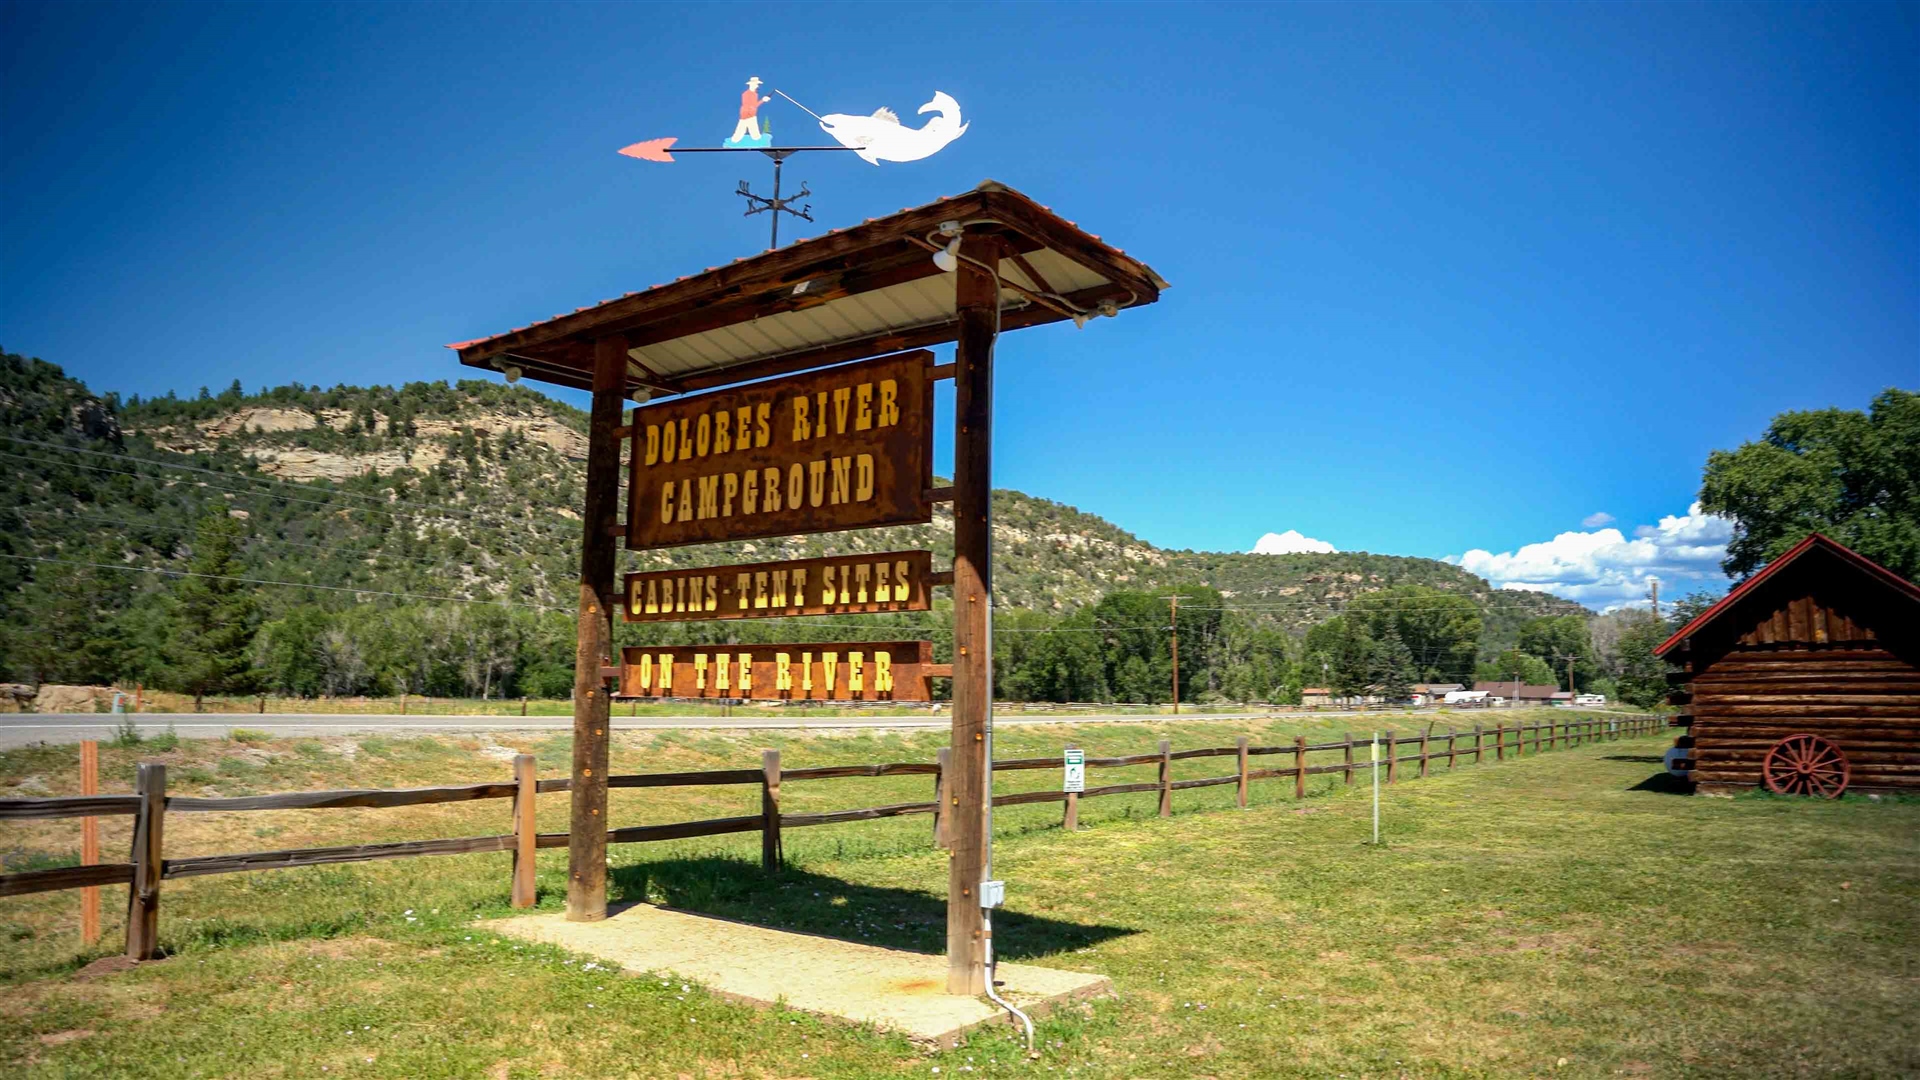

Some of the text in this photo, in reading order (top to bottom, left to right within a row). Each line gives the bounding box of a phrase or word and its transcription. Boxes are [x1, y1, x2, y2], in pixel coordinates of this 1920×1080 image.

[645, 379, 900, 466] DOLORES RIVER
[661, 453, 875, 524] CAMPGROUND
[822, 560, 910, 605] SITES
[640, 651, 893, 692] ON THE RIVER
